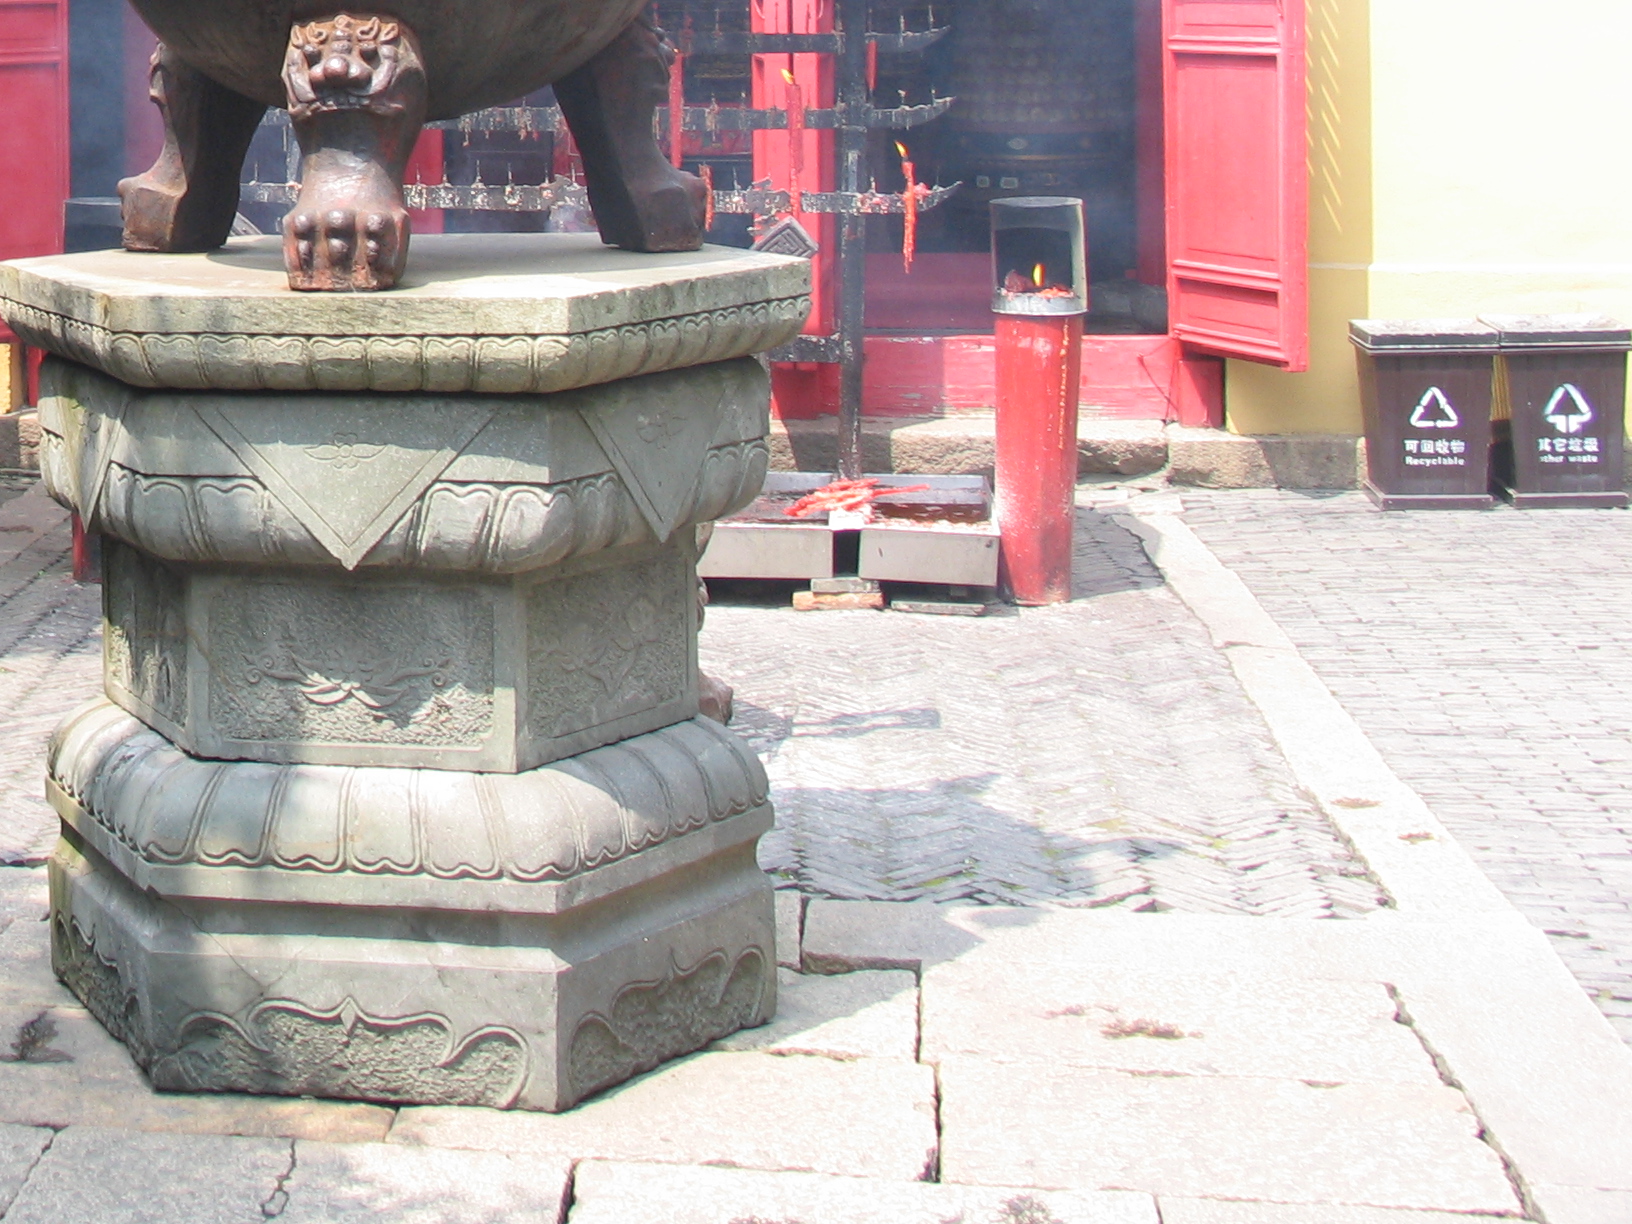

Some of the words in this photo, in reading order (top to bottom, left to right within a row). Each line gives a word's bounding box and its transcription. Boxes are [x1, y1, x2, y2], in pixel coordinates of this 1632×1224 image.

[1403, 438, 1466, 455] 可回收物
[1538, 436, 1600, 453] 其它垃圾
[1405, 456, 1466, 467] Recyclable
